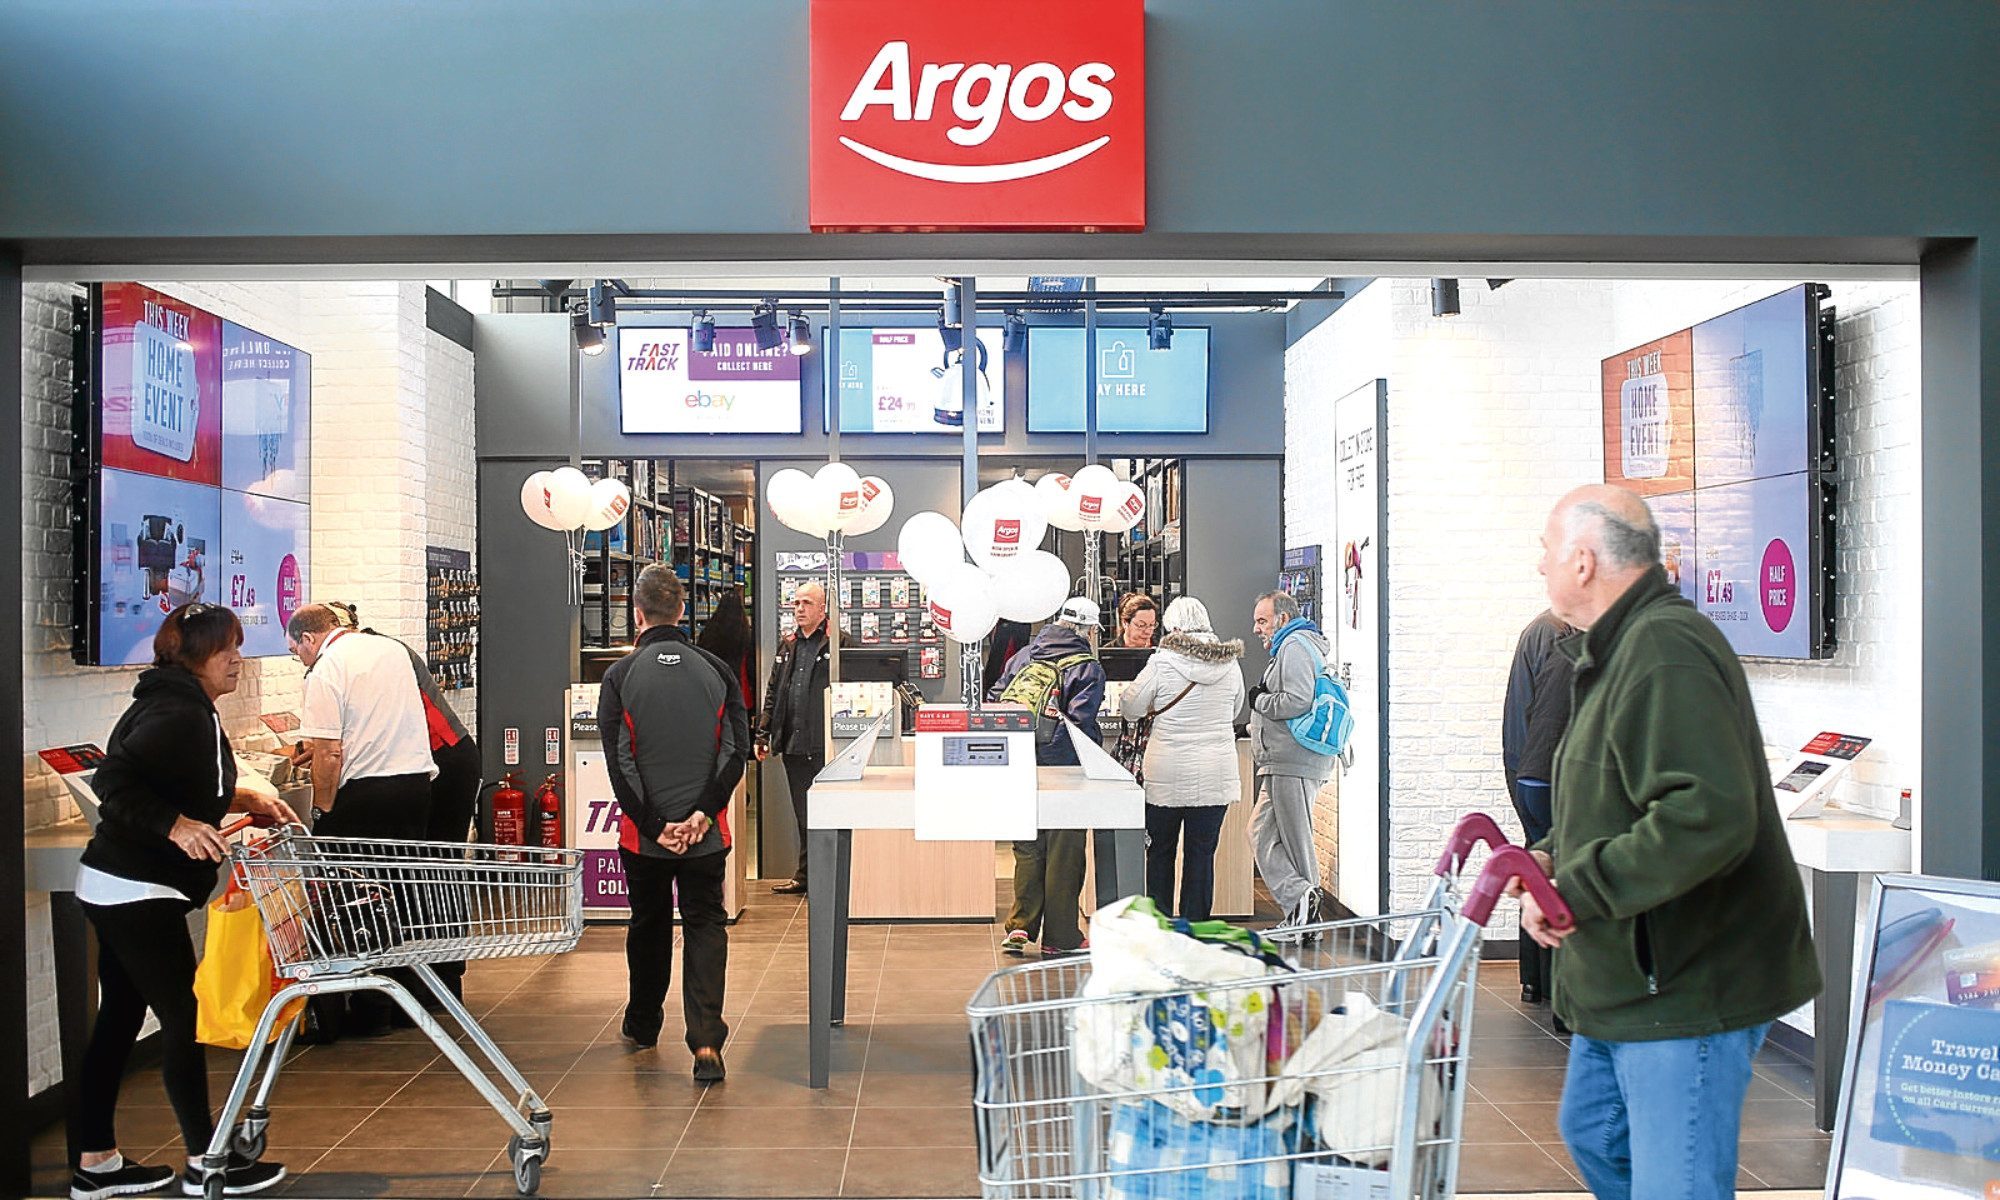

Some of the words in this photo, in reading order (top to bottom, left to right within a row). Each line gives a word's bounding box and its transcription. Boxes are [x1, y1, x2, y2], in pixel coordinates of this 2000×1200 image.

[839, 40, 1117, 146] Argos
[144, 300, 166, 333] THIS
[166, 307, 190, 342] WEEK
[640, 343, 680, 357] FAST
[702, 343, 731, 357] AID
[148, 338, 183, 388] HOME
[627, 357, 679, 371] TRACK
[717, 361, 750, 371] COLLECT
[752, 361, 773, 371] HERE
[1627, 356, 1642, 379] THIS
[1643, 349, 1662, 376] WEEK
[1115, 384, 1146, 396] HERE
[145, 383, 184, 433] EVENT
[685, 390, 736, 410] ebay
[878, 396, 903, 411] £24
[1630, 384, 1658, 419] HOME
[1630, 421, 1660, 457] EVENT
[997, 525, 1018, 536] Argos
[1769, 565, 1786, 583] HALF
[1706, 569, 1734, 604] £7.49
[1768, 588, 1787, 606] PRICE
[657, 653, 681, 662] Argos
[573, 722, 599, 731] Please
[834, 722, 857, 731] Please
[1098, 721, 1118, 730] lease
[598, 858, 625, 874] PAI
[598, 880, 629, 895] COL
[1931, 1039, 1999, 1062] Travel
[1902, 1054, 1972, 1080] Money
[1976, 1063, 2000, 1082] Ca
[1901, 1082, 1919, 1093] Get
[1919, 1085, 1952, 1098] better
[1953, 1089, 1991, 1103] instore
[1903, 1095, 1916, 1104] on
[1917, 1097, 1931, 1107] all
[1933, 1099, 1957, 1110] Card
[1959, 1103, 2000, 1117] currenc
